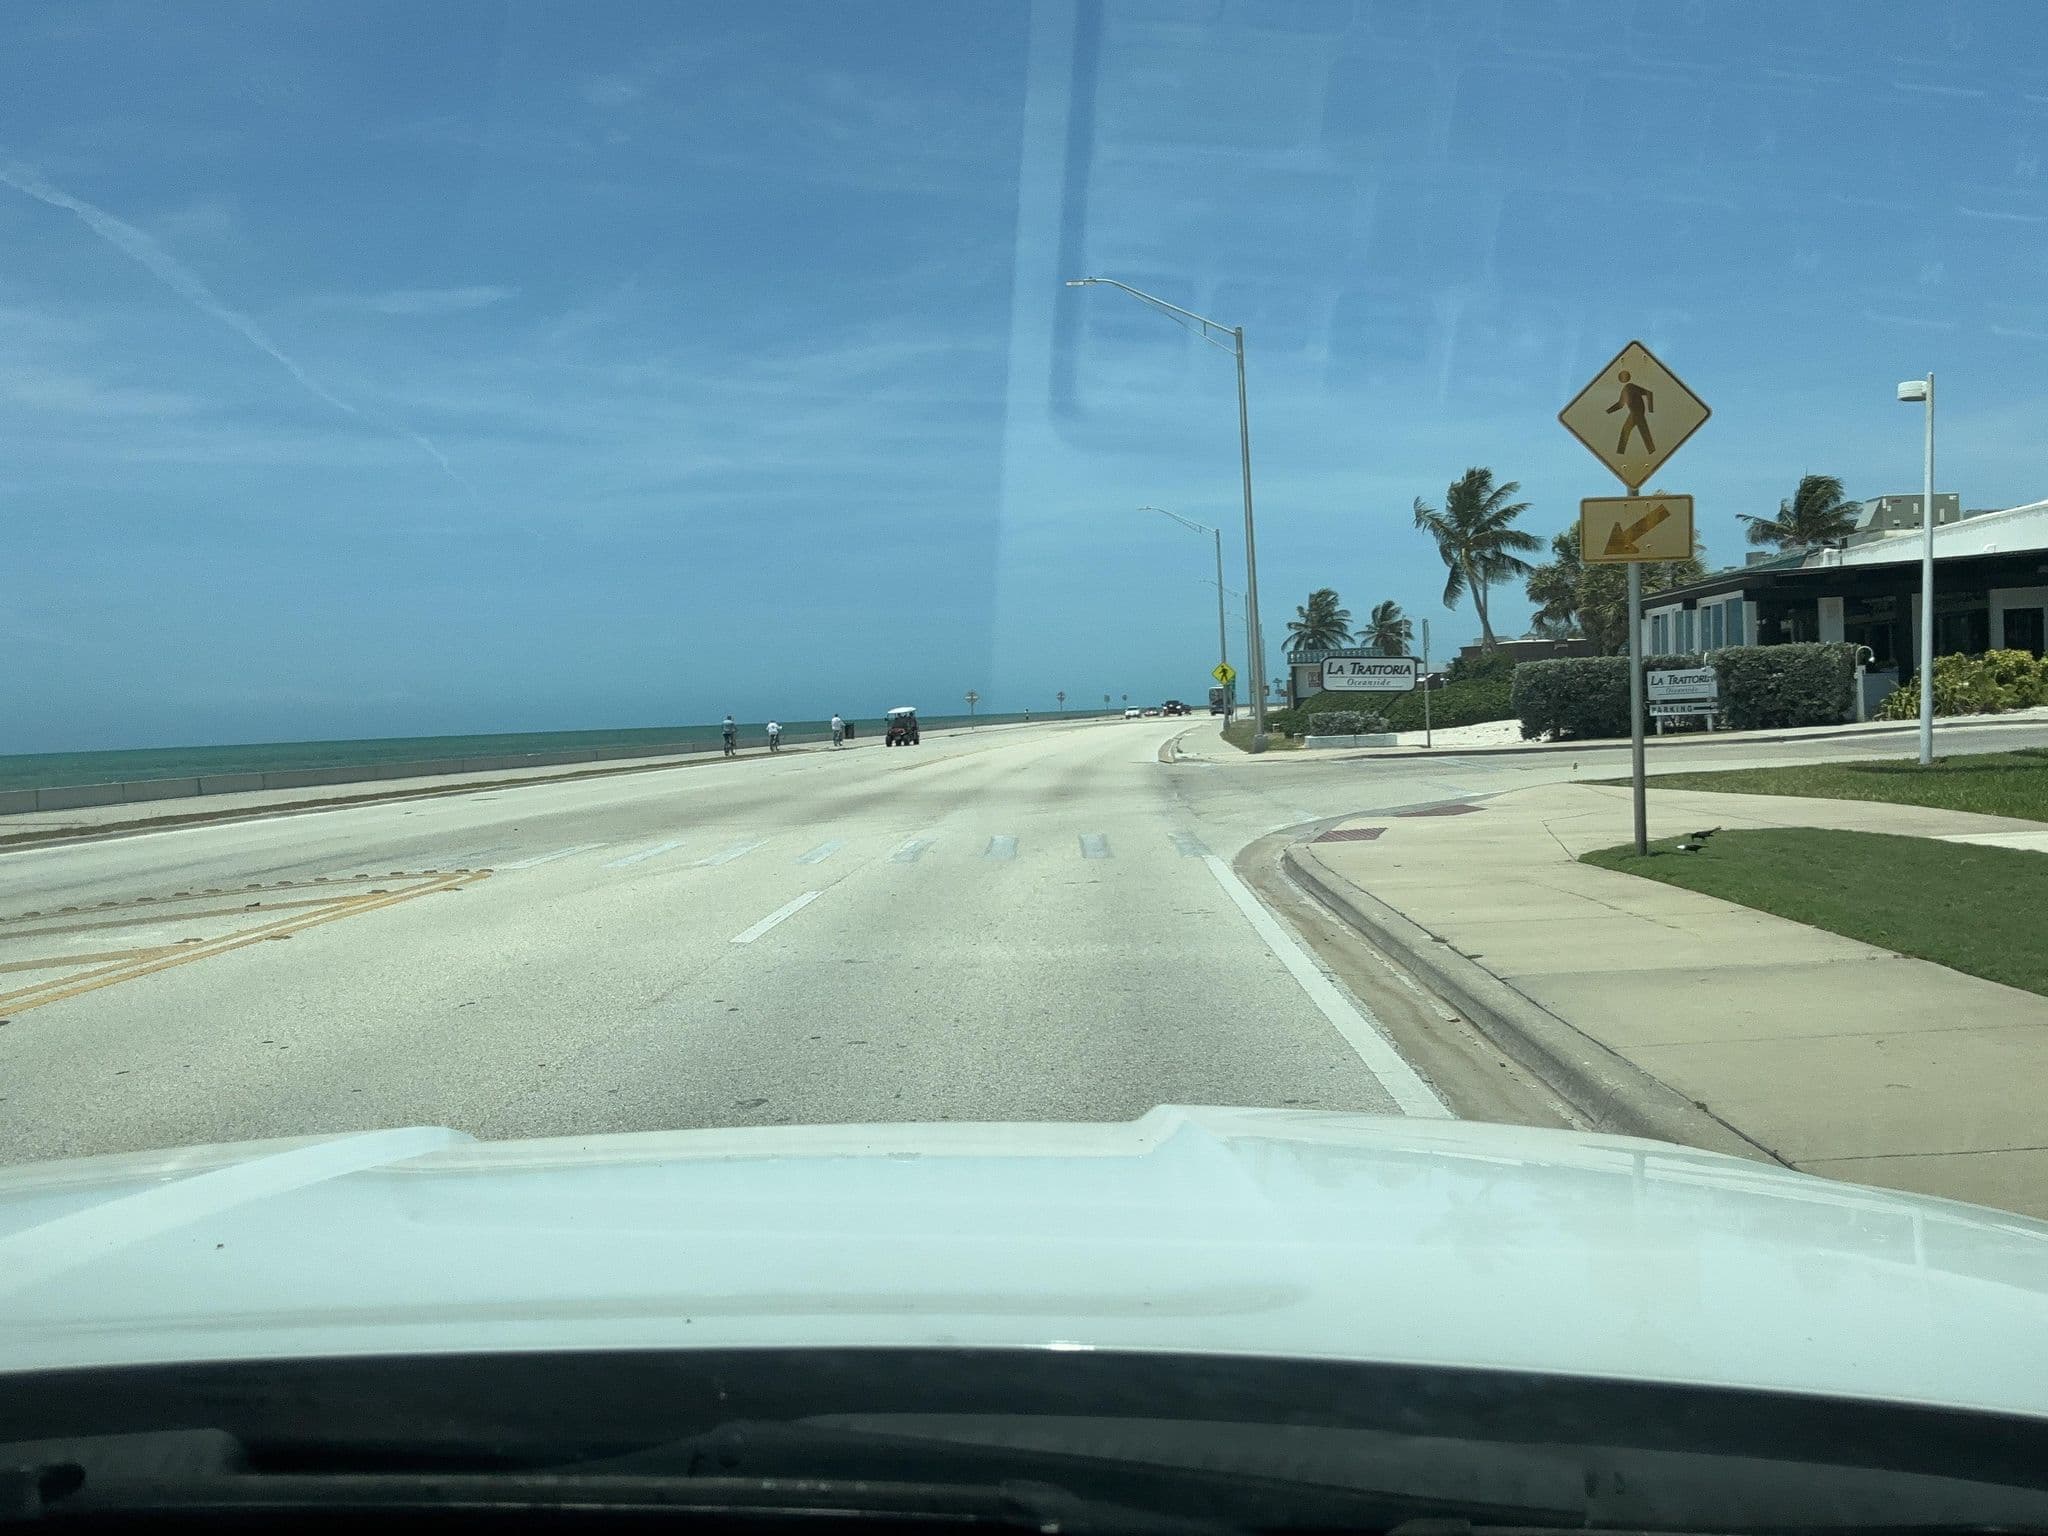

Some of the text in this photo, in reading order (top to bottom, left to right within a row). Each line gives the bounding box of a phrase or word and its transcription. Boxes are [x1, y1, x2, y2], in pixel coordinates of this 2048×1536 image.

[1327, 662, 1411, 675] LA TRATTORIA
[1347, 678, 1391, 686] Oceanside
[1650, 675, 1663, 685] LA
[1651, 705, 1693, 713] PARKING
